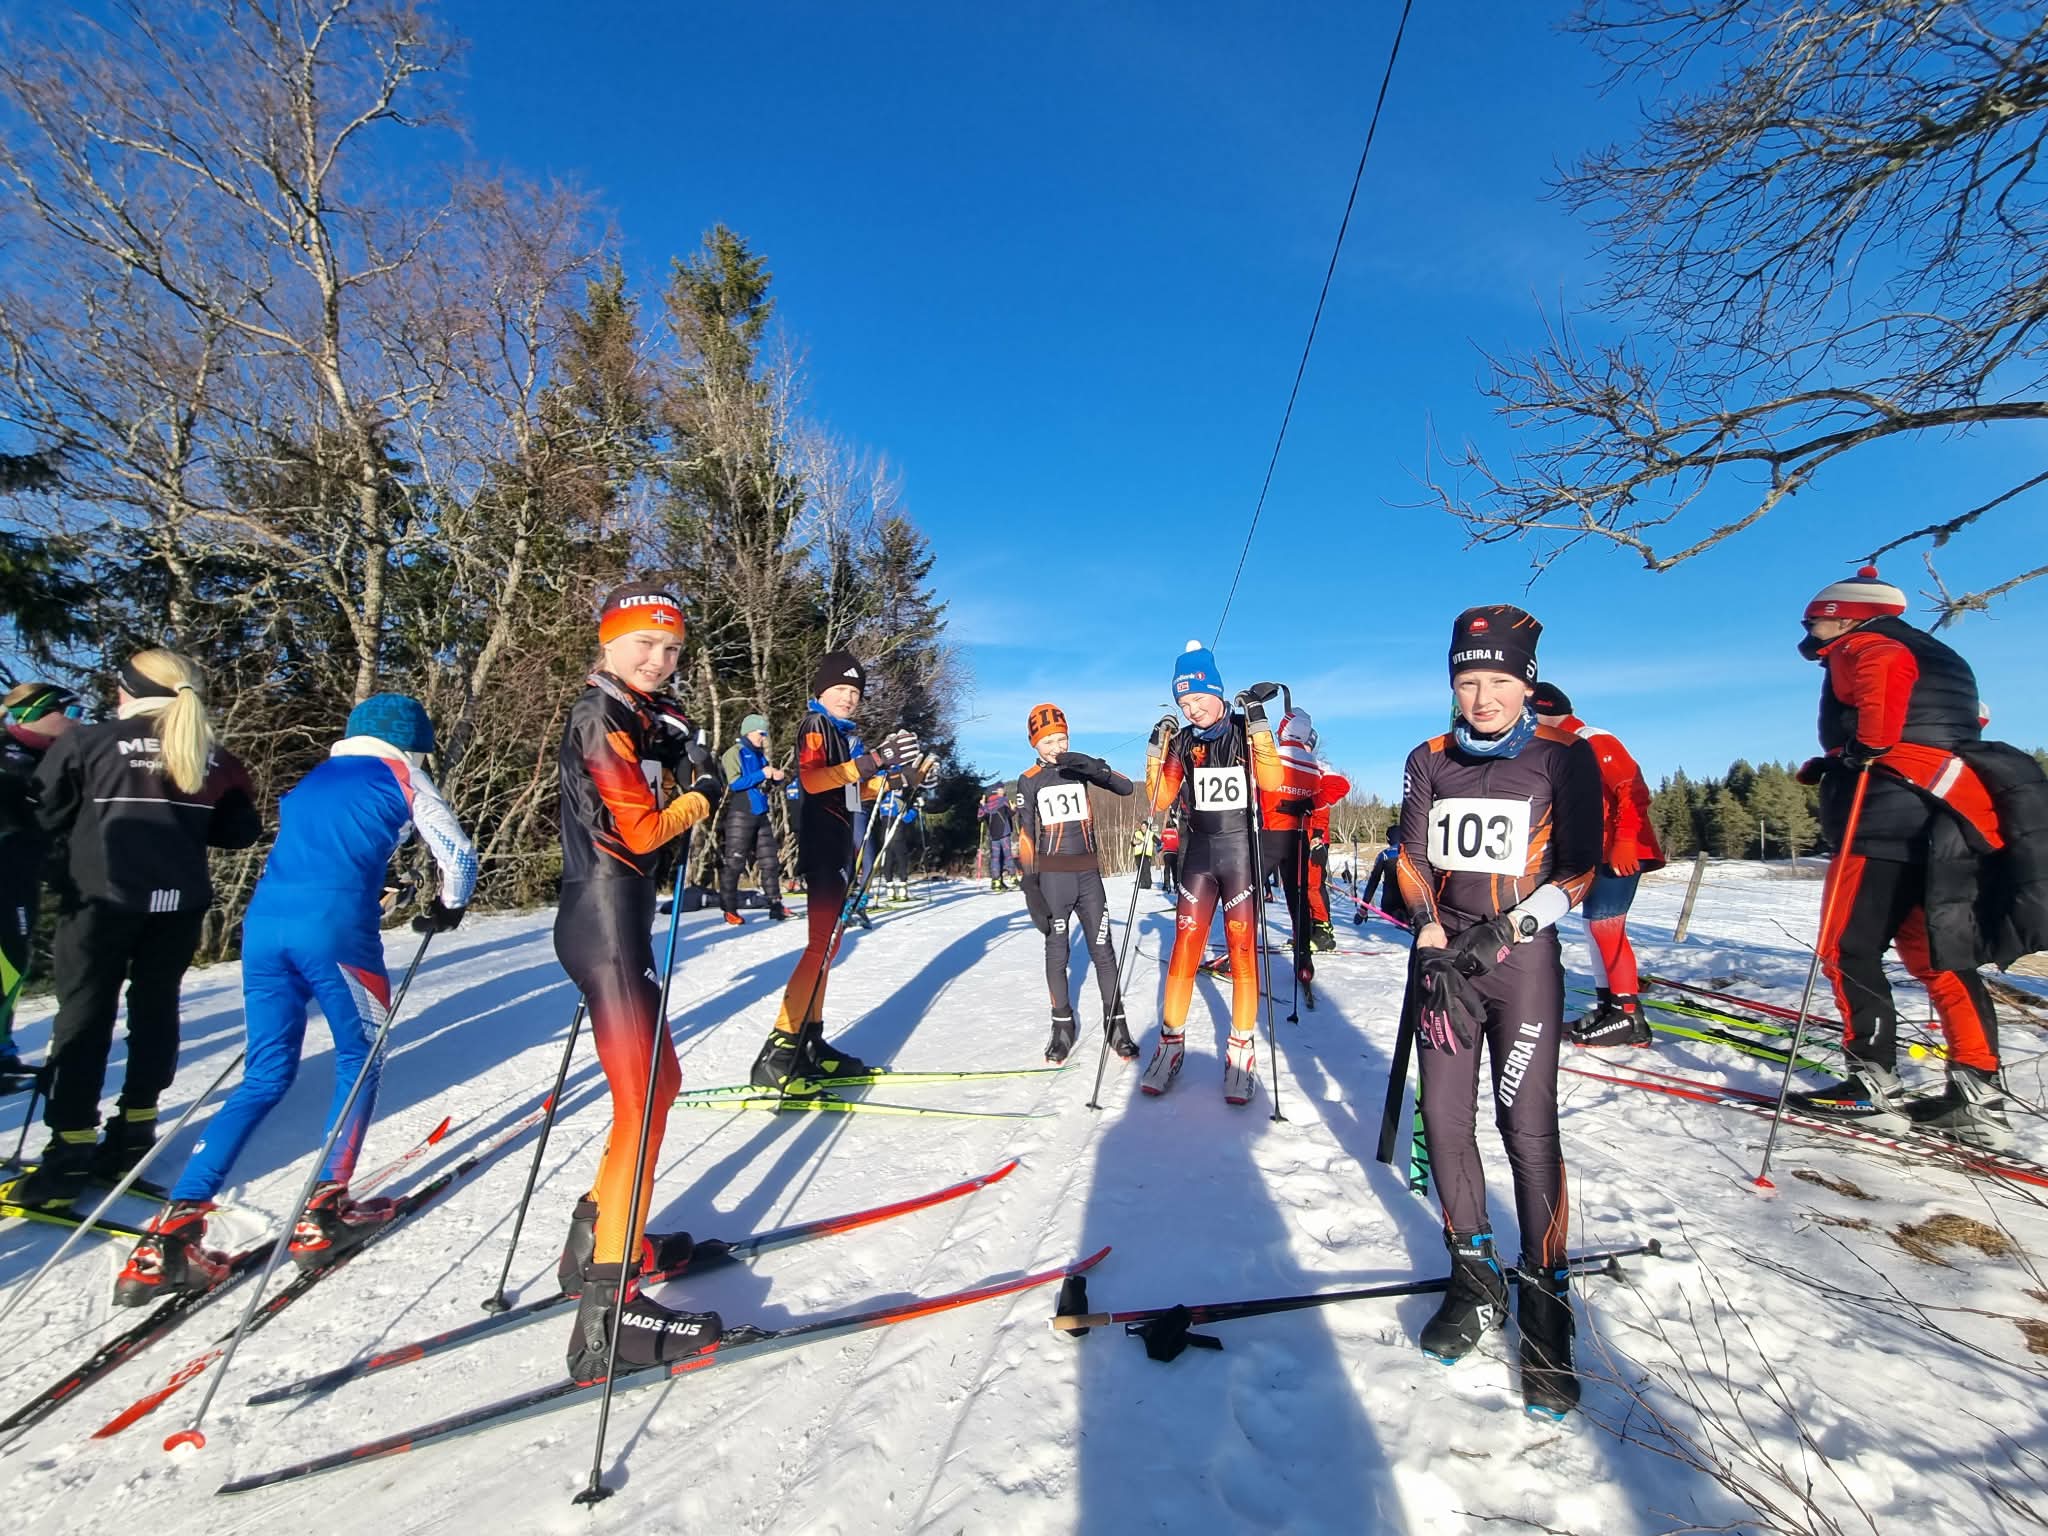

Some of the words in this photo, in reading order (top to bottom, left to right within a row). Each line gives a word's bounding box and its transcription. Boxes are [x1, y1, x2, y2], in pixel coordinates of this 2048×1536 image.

[1452, 648, 1492, 665] UTLEIRA
[1495, 650, 1505, 661] IL
[1198, 776, 1241, 803] 126
[1044, 792, 1081, 817] 131
[1437, 812, 1514, 861] 103
[1223, 889, 1251, 912] UTLEIRA
[1582, 1019, 1631, 1041] MADSHUS
[1498, 1041, 1537, 1108] UTLEIRA
[1519, 1022, 1543, 1039] IL
